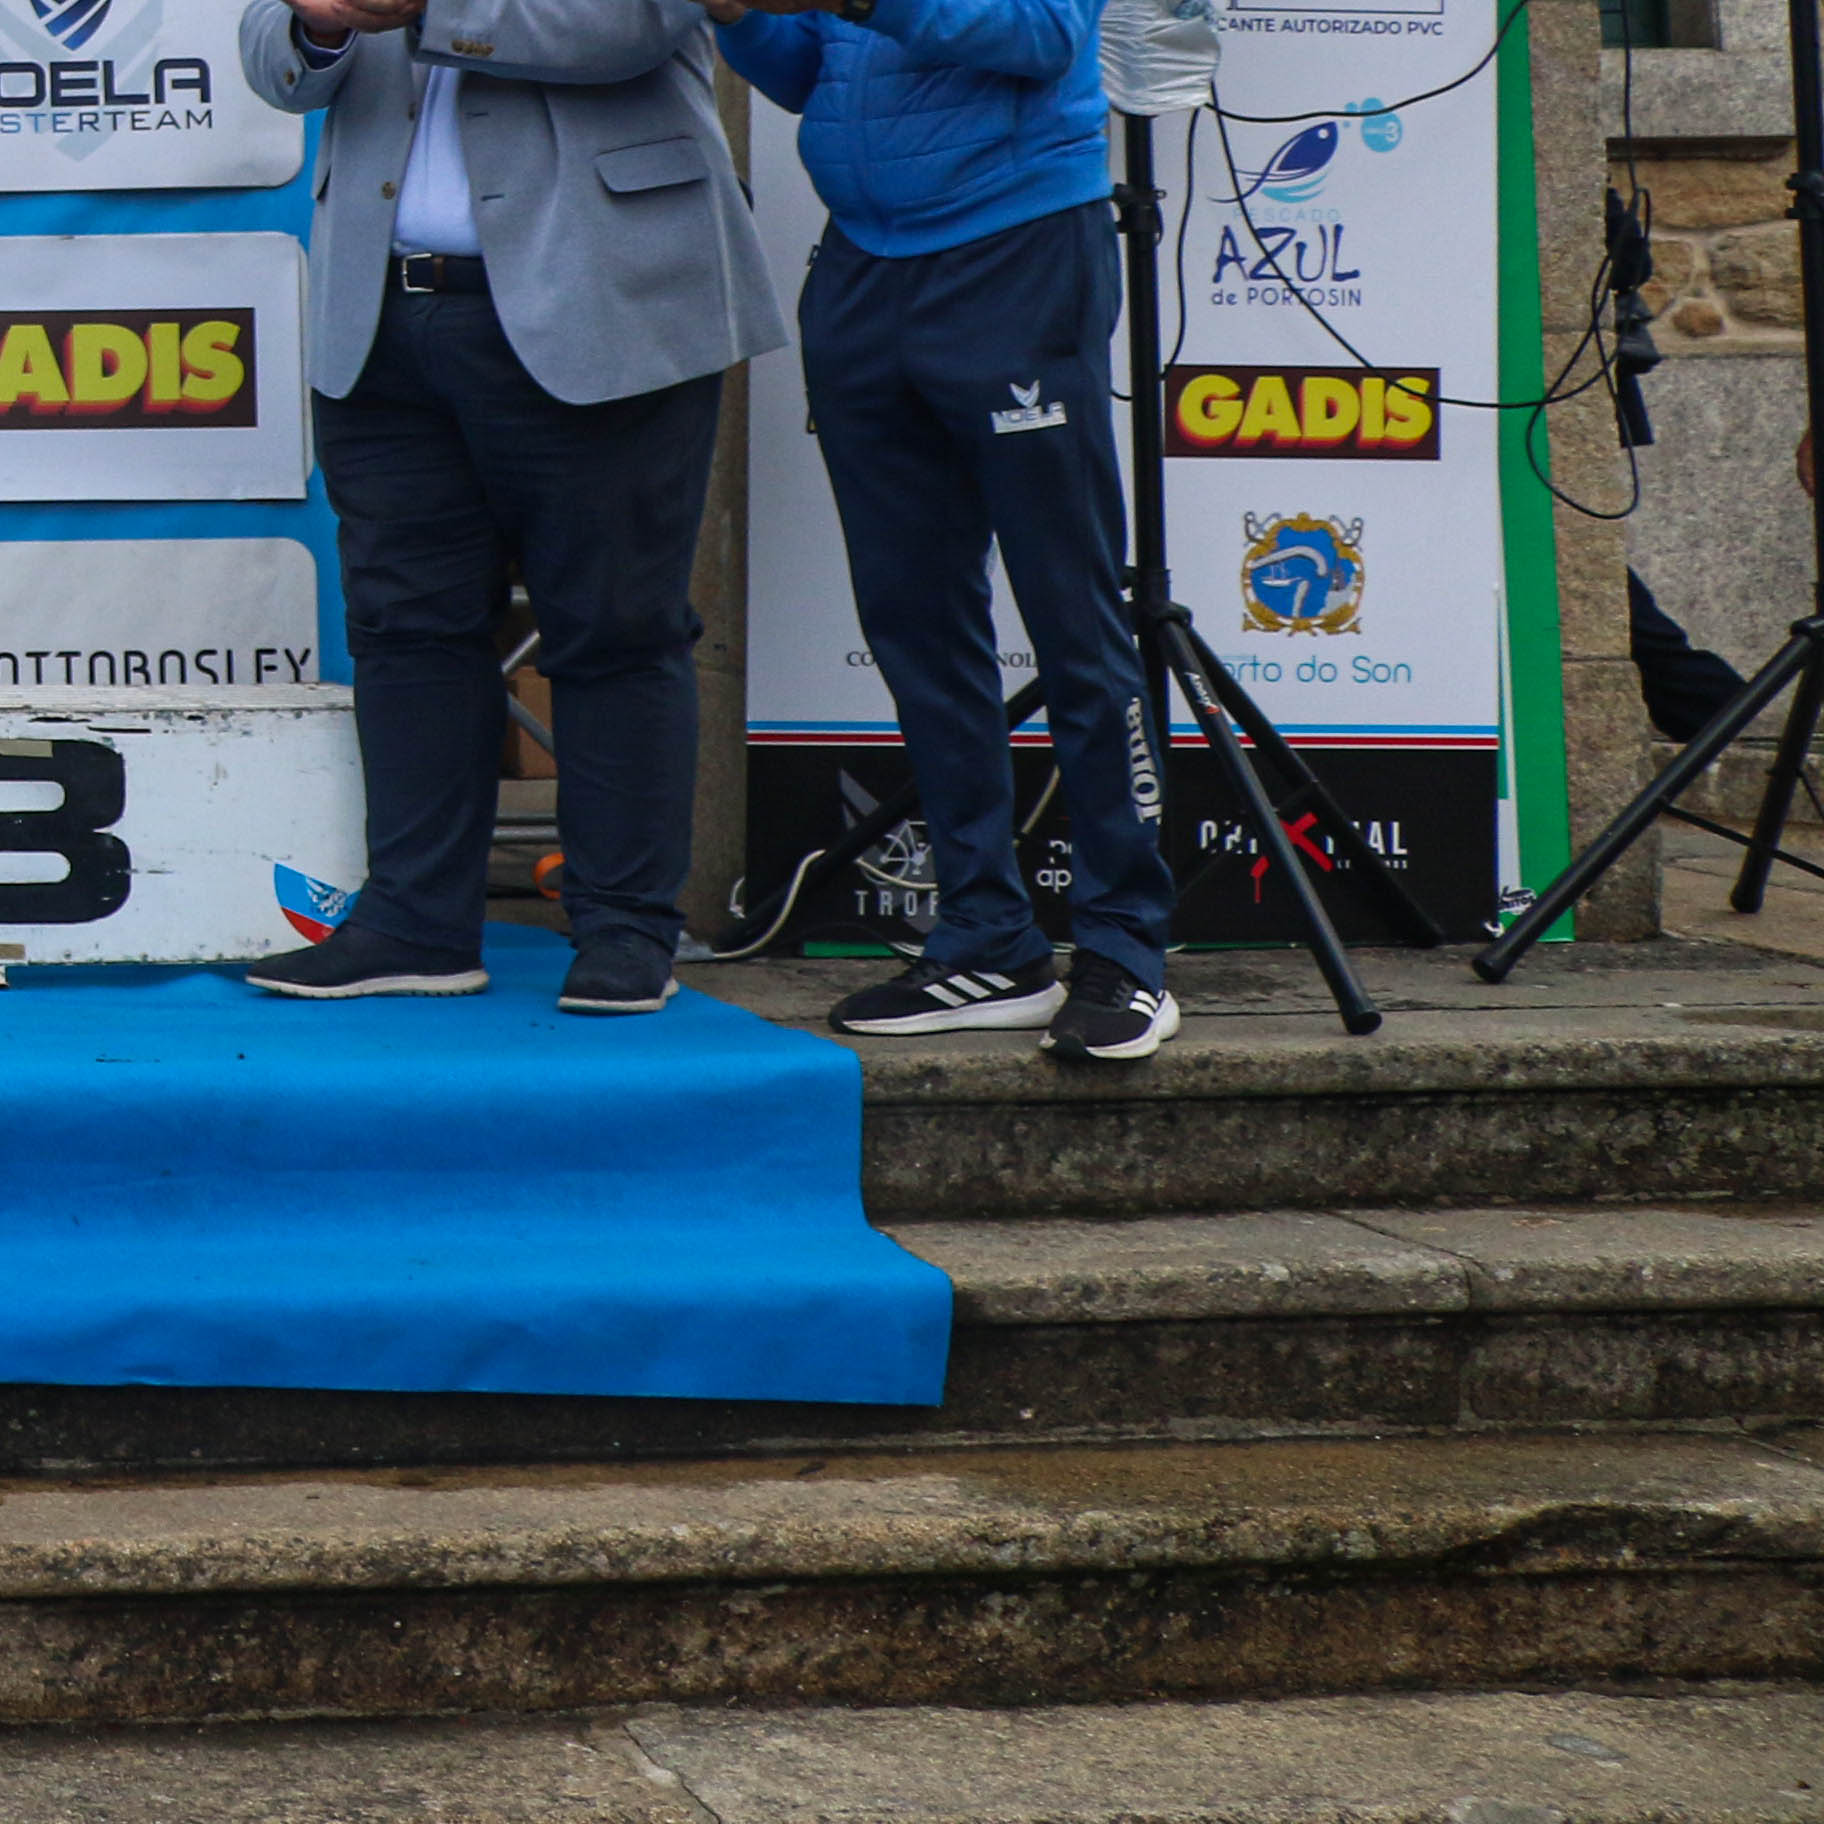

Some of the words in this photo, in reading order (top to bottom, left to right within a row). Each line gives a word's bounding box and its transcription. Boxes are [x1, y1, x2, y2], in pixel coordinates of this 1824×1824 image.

[1280, 18, 1402, 35] AUTORIZADO
[1407, 21, 1444, 36] PVC
[1213, 225, 1360, 283] AZUL
[1212, 288, 1237, 307] de
[1177, 373, 1434, 446] GADIS
[1296, 655, 1337, 683] do
[1351, 655, 1412, 684] Son
